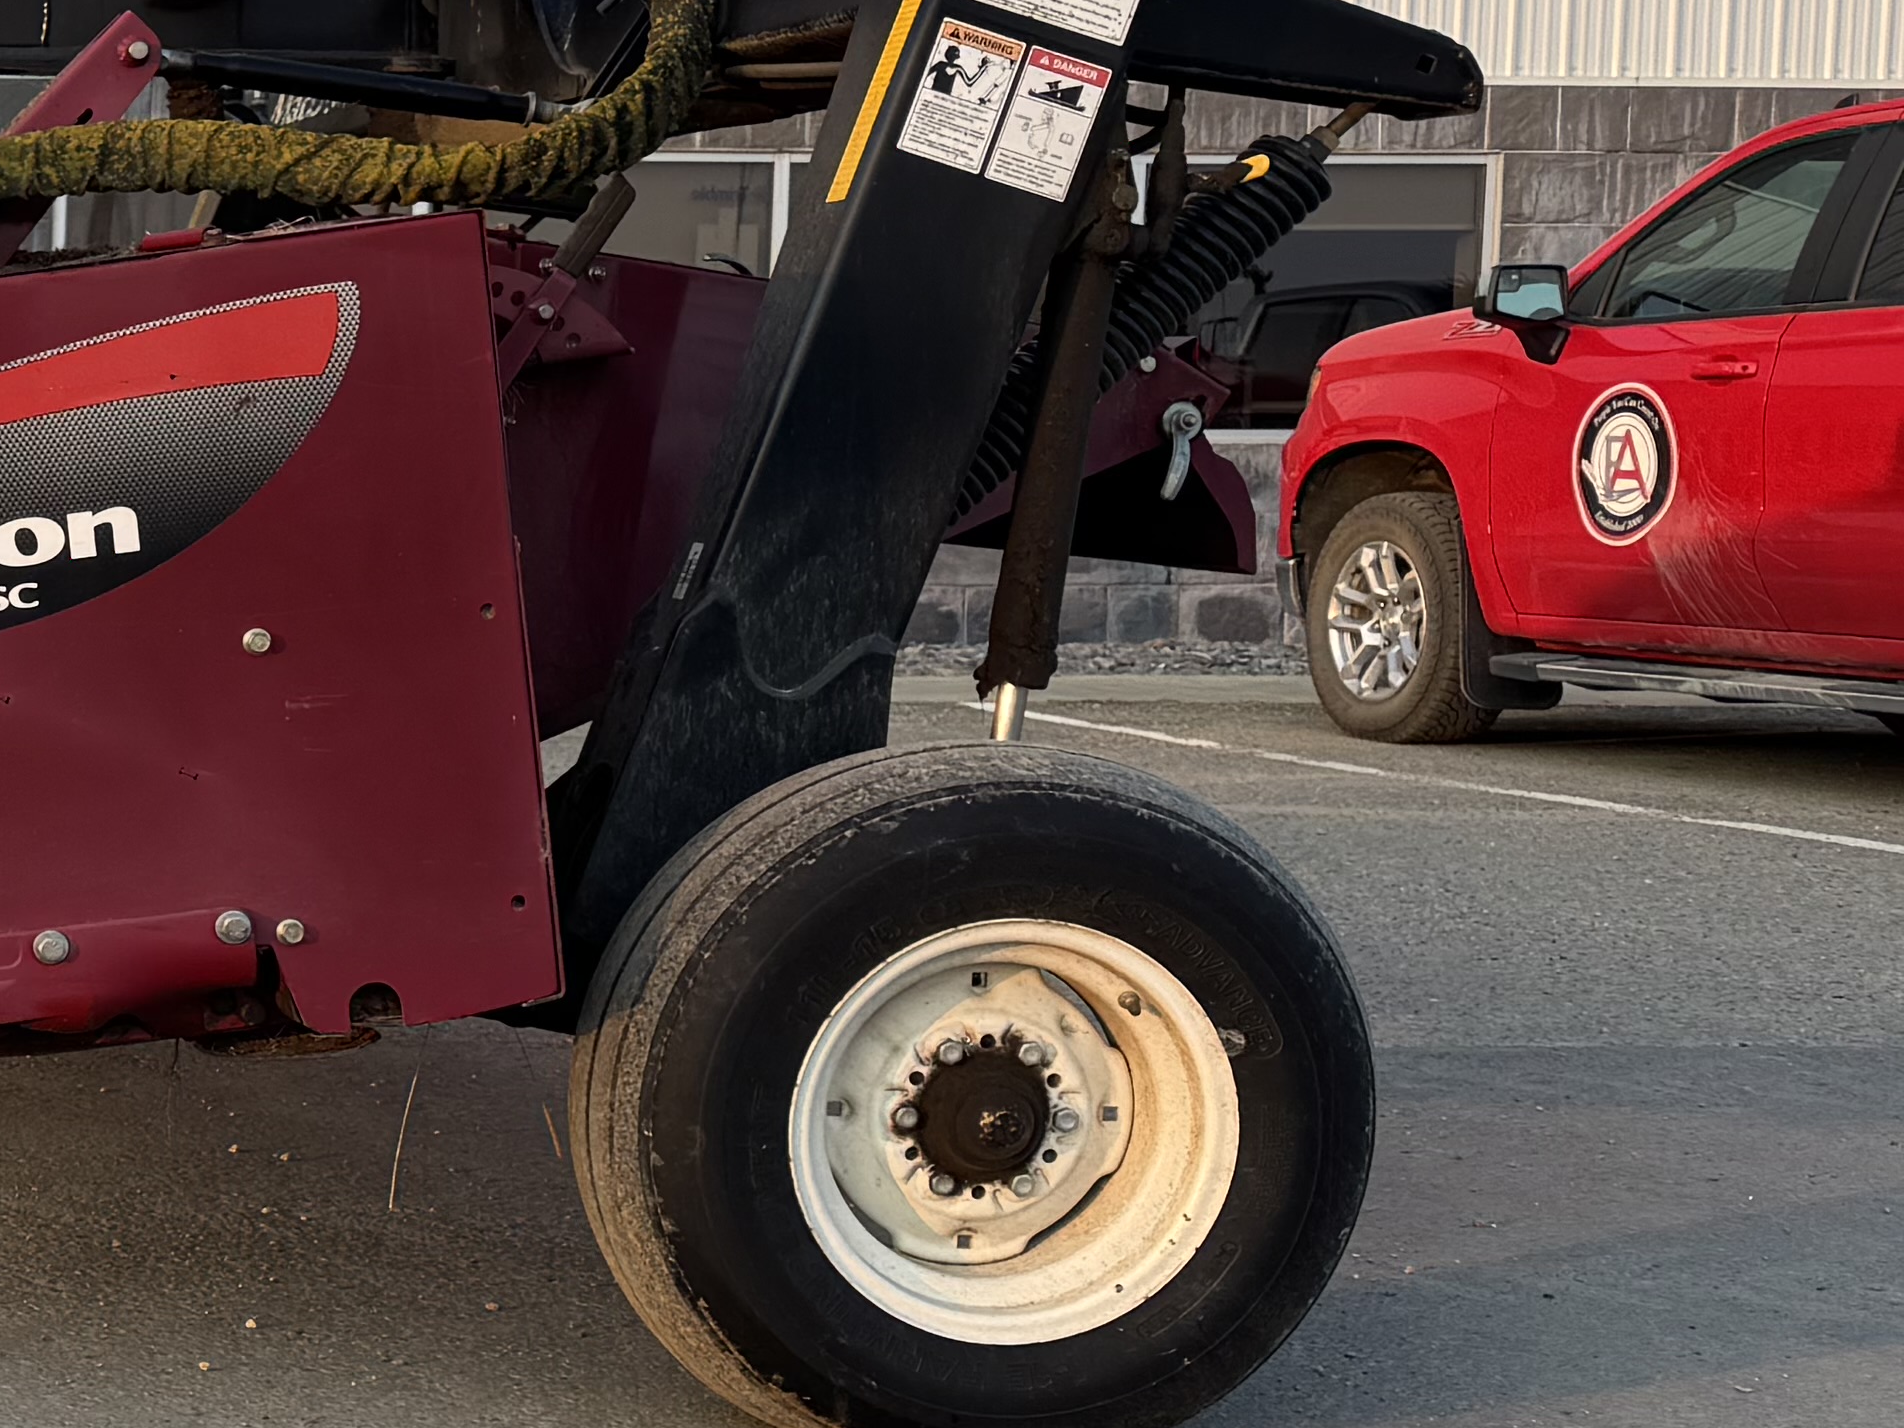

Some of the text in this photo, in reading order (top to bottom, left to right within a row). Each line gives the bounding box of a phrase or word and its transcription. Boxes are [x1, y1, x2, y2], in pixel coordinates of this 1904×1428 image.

[962, 29, 1015, 57] WARNING
[1052, 58, 1099, 81] DANGER
[1153, 922, 1276, 1048] ADVANCE
